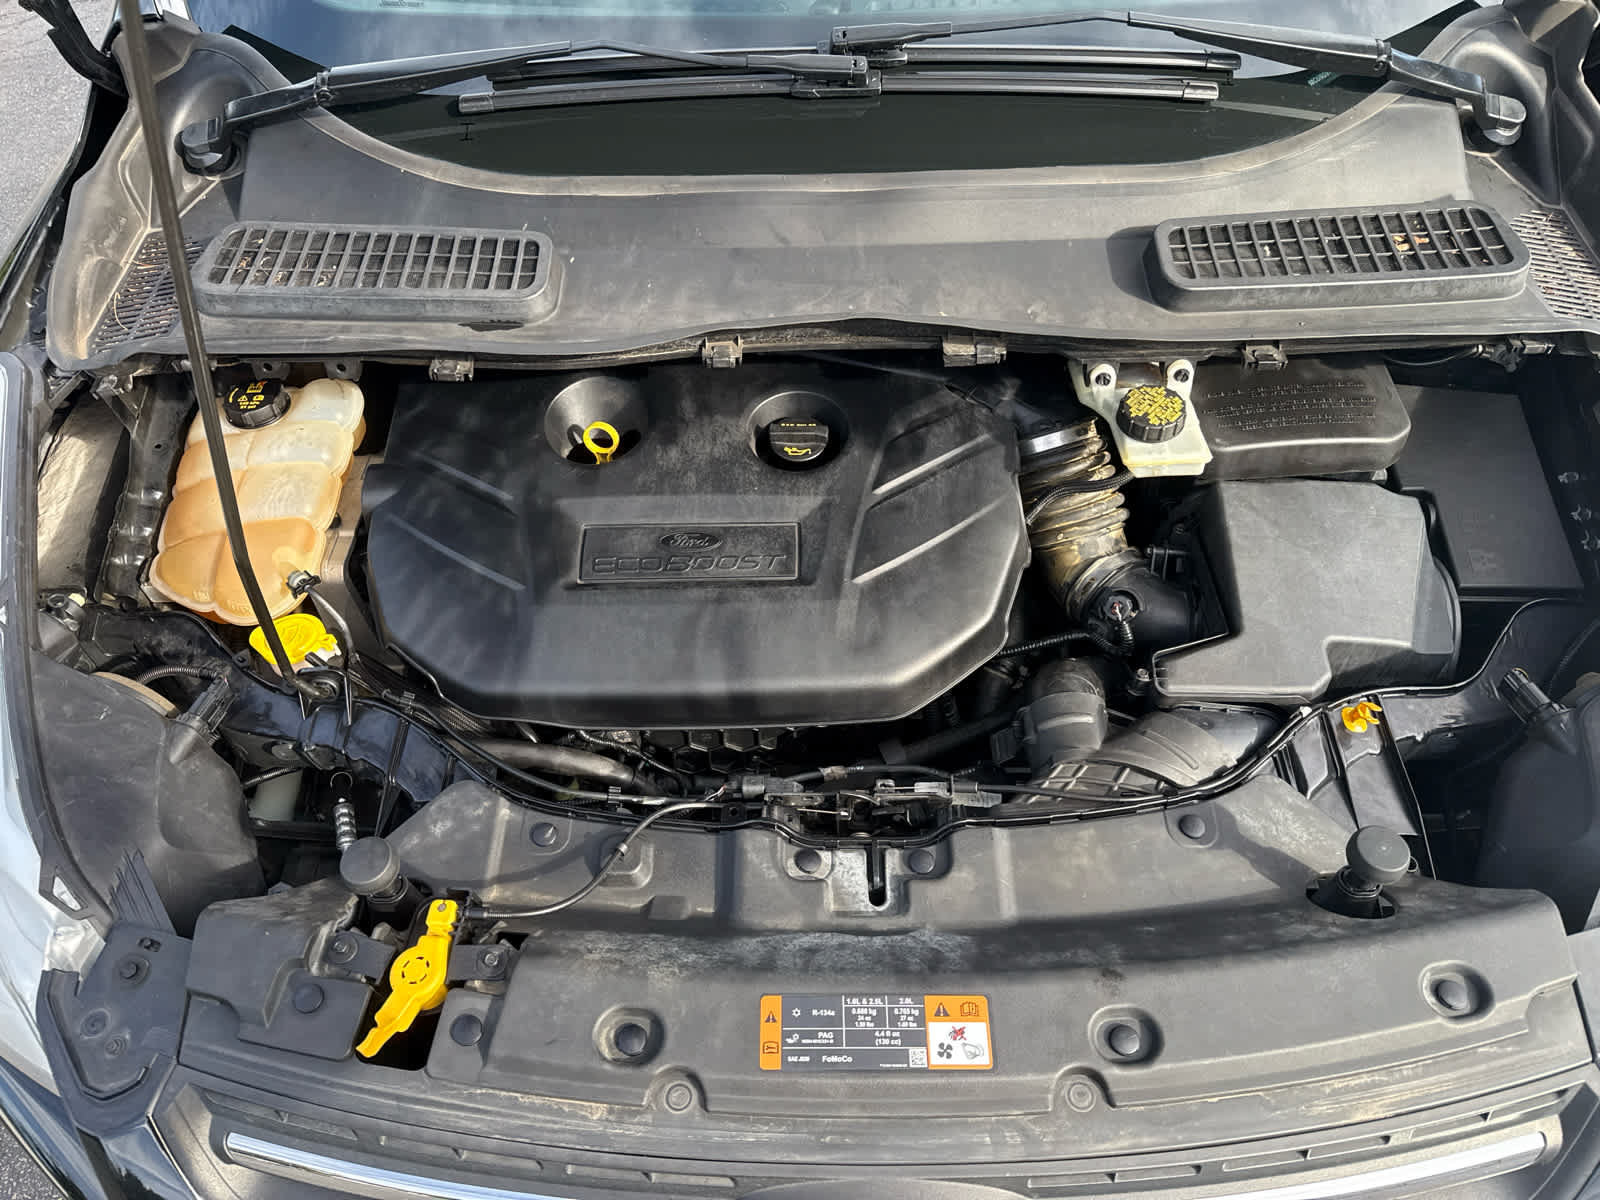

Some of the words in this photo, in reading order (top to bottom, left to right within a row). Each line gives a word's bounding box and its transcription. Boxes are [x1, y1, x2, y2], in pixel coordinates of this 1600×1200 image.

[811, 1008, 836, 1016] R-134a
[817, 1031, 834, 1039] PAG
[822, 1055, 853, 1063] FoMoCo
